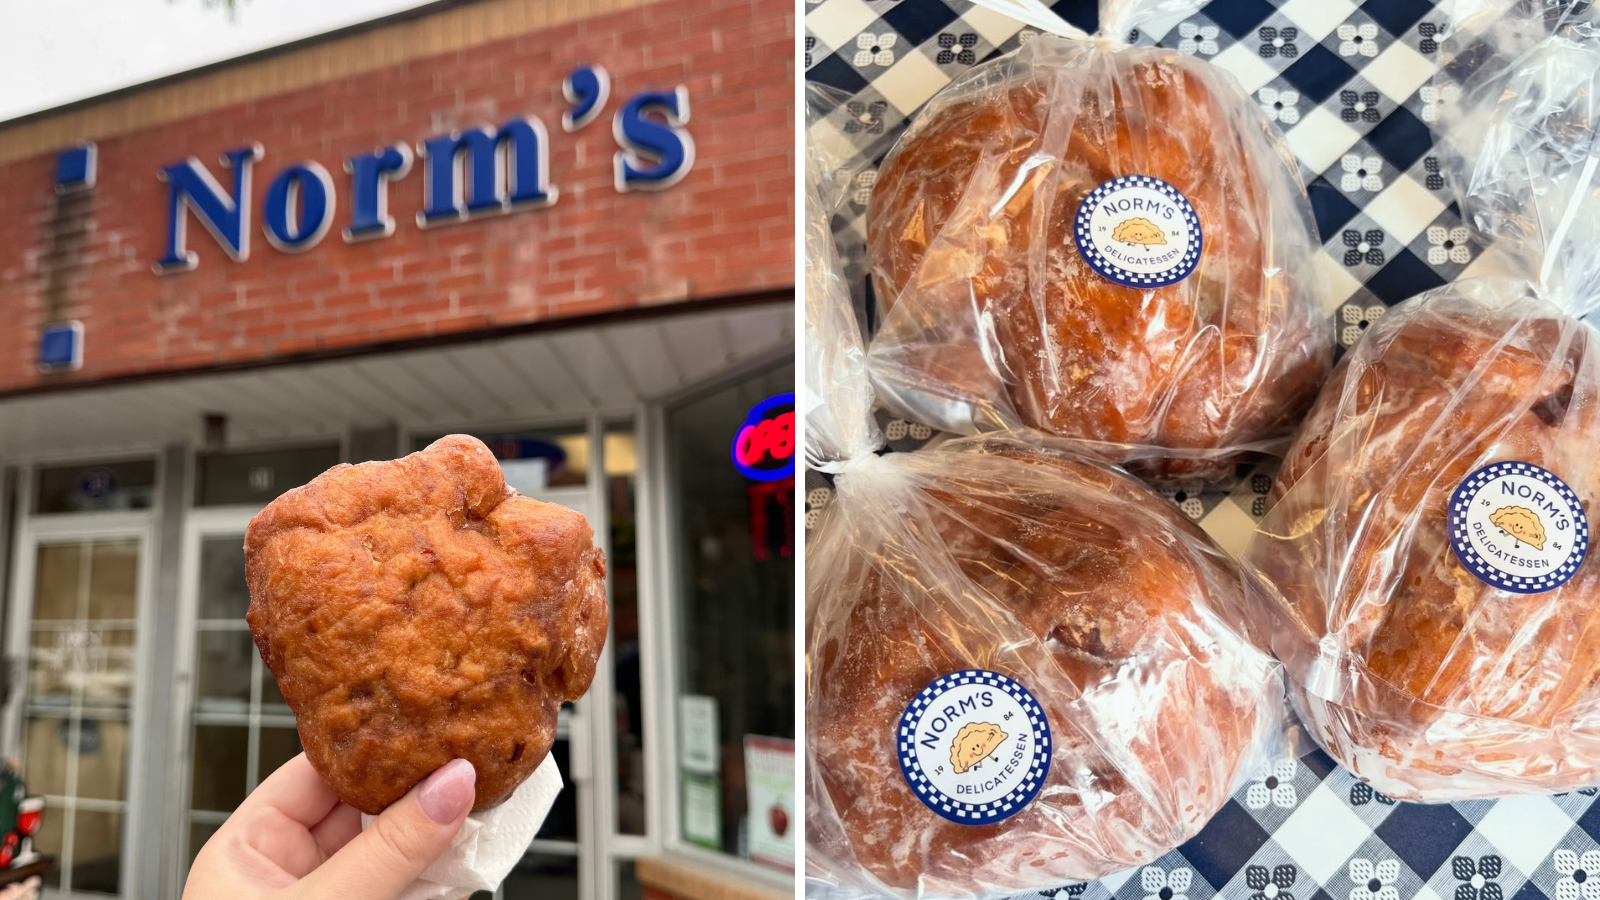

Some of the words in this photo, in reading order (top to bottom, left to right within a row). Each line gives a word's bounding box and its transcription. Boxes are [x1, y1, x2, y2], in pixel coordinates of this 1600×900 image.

[152, 65, 696, 275] Norm's
[1102, 197, 1175, 220] NORM'S
[1104, 245, 1180, 265] DELICATESSEN
[1480, 499, 1491, 507] 19
[1552, 541, 1562, 550] 84
[1501, 480, 1570, 531] NORM'S
[1472, 521, 1550, 568] DELICATESSEN
[920, 691, 994, 750] NORM'S
[934, 765, 944, 776] 19
[1003, 711, 1014, 721] 84
[956, 733, 1028, 794] DELICATESSEN
